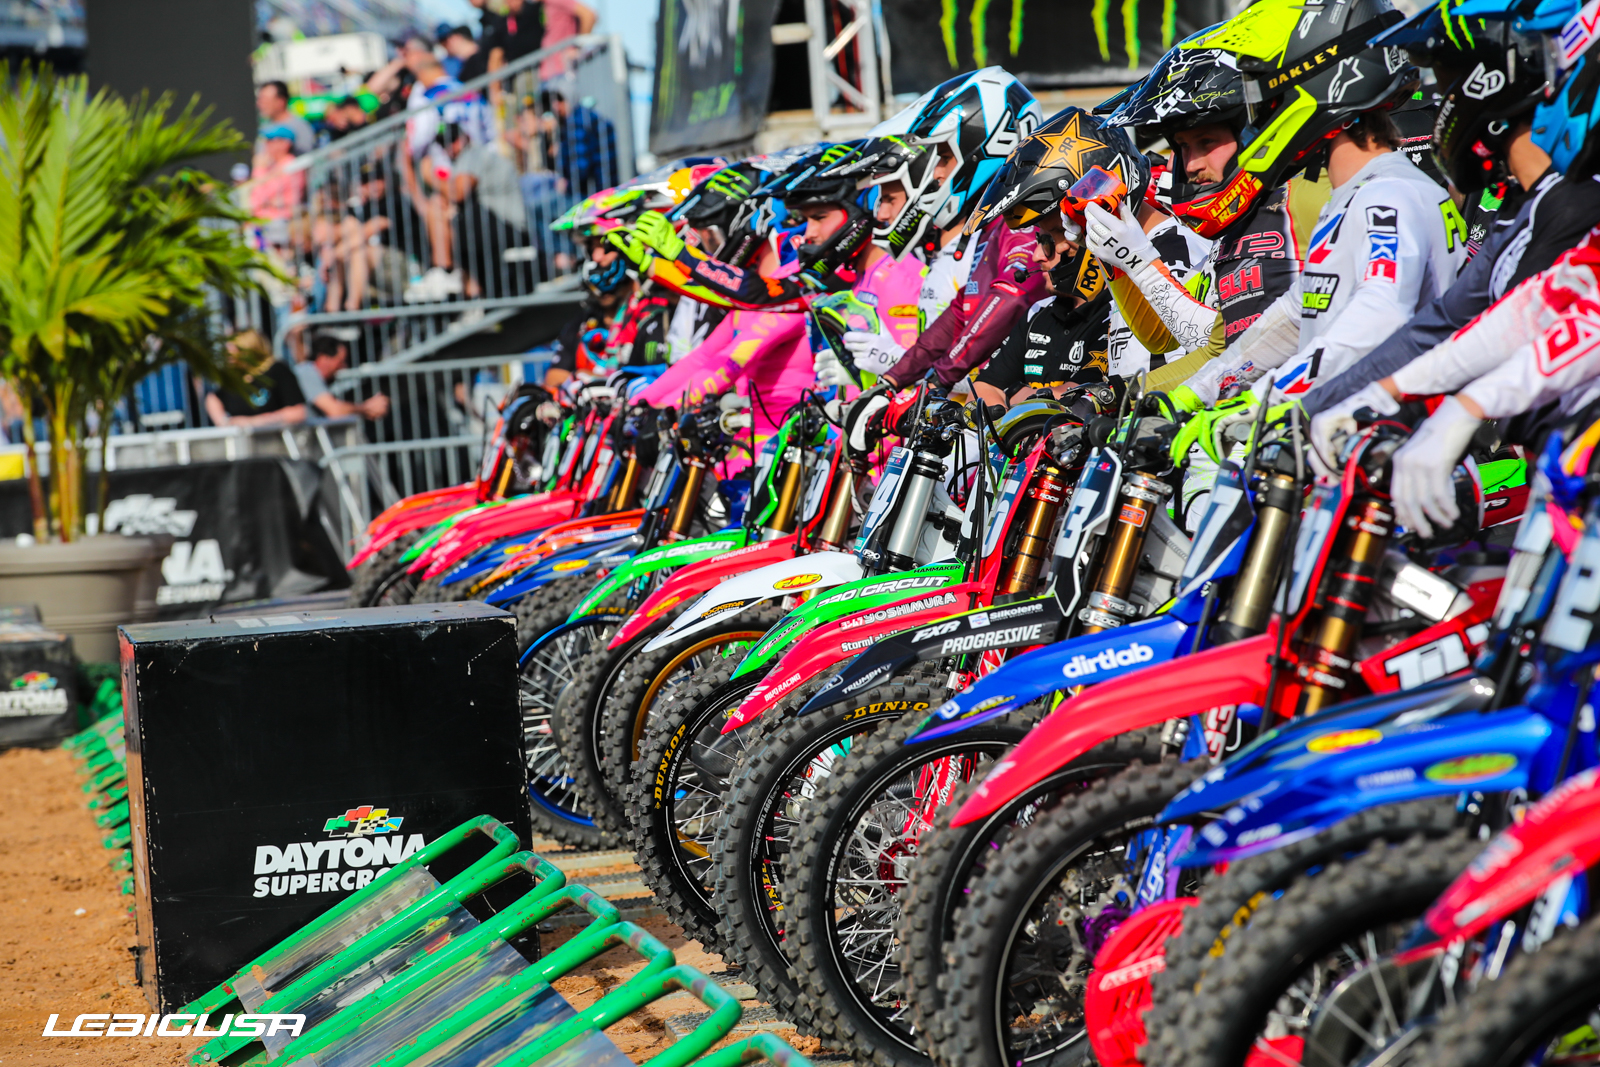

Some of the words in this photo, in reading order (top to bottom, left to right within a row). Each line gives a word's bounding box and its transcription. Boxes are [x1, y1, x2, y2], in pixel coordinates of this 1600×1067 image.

[1268, 44, 1339, 90] OAKLEY
[1396, 142, 1433, 153] Kawasak
[983, 183, 1021, 221] FLY
[1103, 236, 1144, 271] FOX
[695, 261, 720, 283] Red
[717, 267, 743, 292] Bull
[1218, 265, 1262, 300] SLH
[1226, 312, 1263, 338] HOND
[868, 347, 898, 367] FOX
[865, 472, 901, 529] 4
[665, 540, 736, 558] CIRCUIT
[711, 541, 770, 563] PROGRESSIVE
[913, 564, 962, 574] HAMMAKER
[774, 573, 822, 591] FMF
[859, 576, 951, 598] CIRCUIT
[700, 600, 745, 618] ROCKSTAR
[863, 591, 957, 625] YOSHIMURA
[989, 603, 1043, 620] Silkolene
[911, 620, 962, 644] FXR
[941, 623, 1043, 654] PROGRESSIVE
[1062, 642, 1154, 679] dirtlab
[778, 673, 801, 693] RACING
[842, 668, 882, 694] TRIUMPH
[654, 724, 687, 801] DUNLOP
[668, 762, 678, 782] EXCEL
[756, 813, 768, 838] EXCEL
[254, 834, 426, 875] DAYTONA
[827, 856, 837, 881] EXCEL
